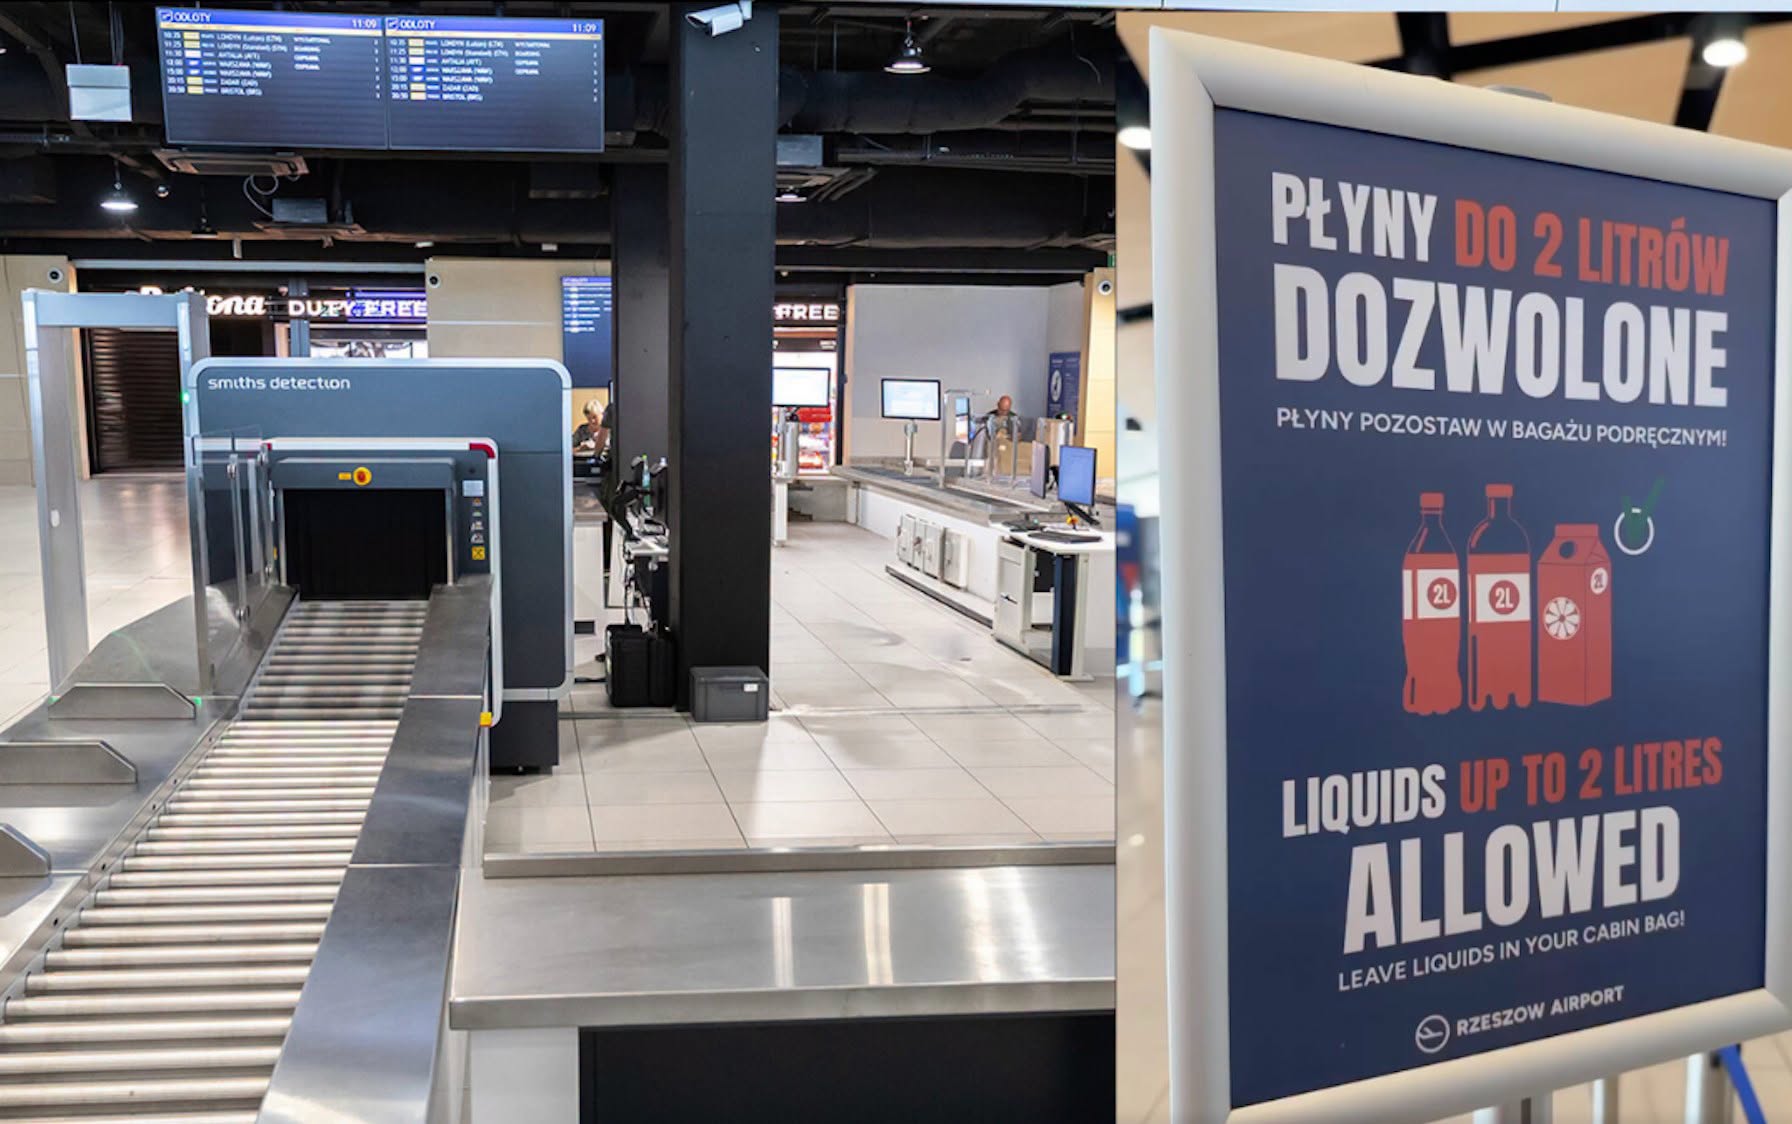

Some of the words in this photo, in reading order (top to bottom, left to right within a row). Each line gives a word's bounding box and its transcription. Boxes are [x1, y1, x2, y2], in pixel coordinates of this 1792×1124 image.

[174, 13, 211, 23] ODLOTY
[352, 18, 377, 29] 11:09
[400, 20, 436, 30] ODLOTY
[572, 23, 597, 33] 11:09
[1272, 171, 1438, 263] PŁYNY
[1455, 199, 1517, 273] DO
[1533, 211, 1563, 278] 2
[1578, 216, 1730, 297] LITRÓW
[288, 300, 352, 318] DUTY
[1273, 262, 1729, 408] DOZWOLONE
[207, 376, 267, 391] smiths
[269, 376, 351, 391] detection
[1276, 407, 1354, 432] PŁYNY
[1360, 413, 1482, 438] POZOSTAW
[1486, 419, 1508, 439] W
[1512, 417, 1592, 443] BAGAŻU
[1596, 424, 1728, 449] PODRĘCZNYM!
[1433, 583, 1452, 605] 2L
[1593, 573, 1605, 589] 2L
[1494, 586, 1514, 609] 2L
[1282, 763, 1447, 839] LIQUIDS
[1459, 757, 1510, 814] UP
[1521, 751, 1567, 807] TO
[1578, 748, 1603, 800] 2
[1613, 736, 1724, 797] LITRES
[1343, 805, 1681, 956] ALLOWED
[1338, 960, 1408, 992] LEAVE
[1412, 942, 1496, 977] LIQUIDS
[1500, 939, 1521, 961] IN
[1524, 930, 1579, 956] YOUR
[1583, 917, 1641, 945] CABIN
[1644, 909, 1686, 932] BAG!
[1456, 1002, 1546, 1038] RZESZOW
[1550, 985, 1625, 1017] AIRPORT
